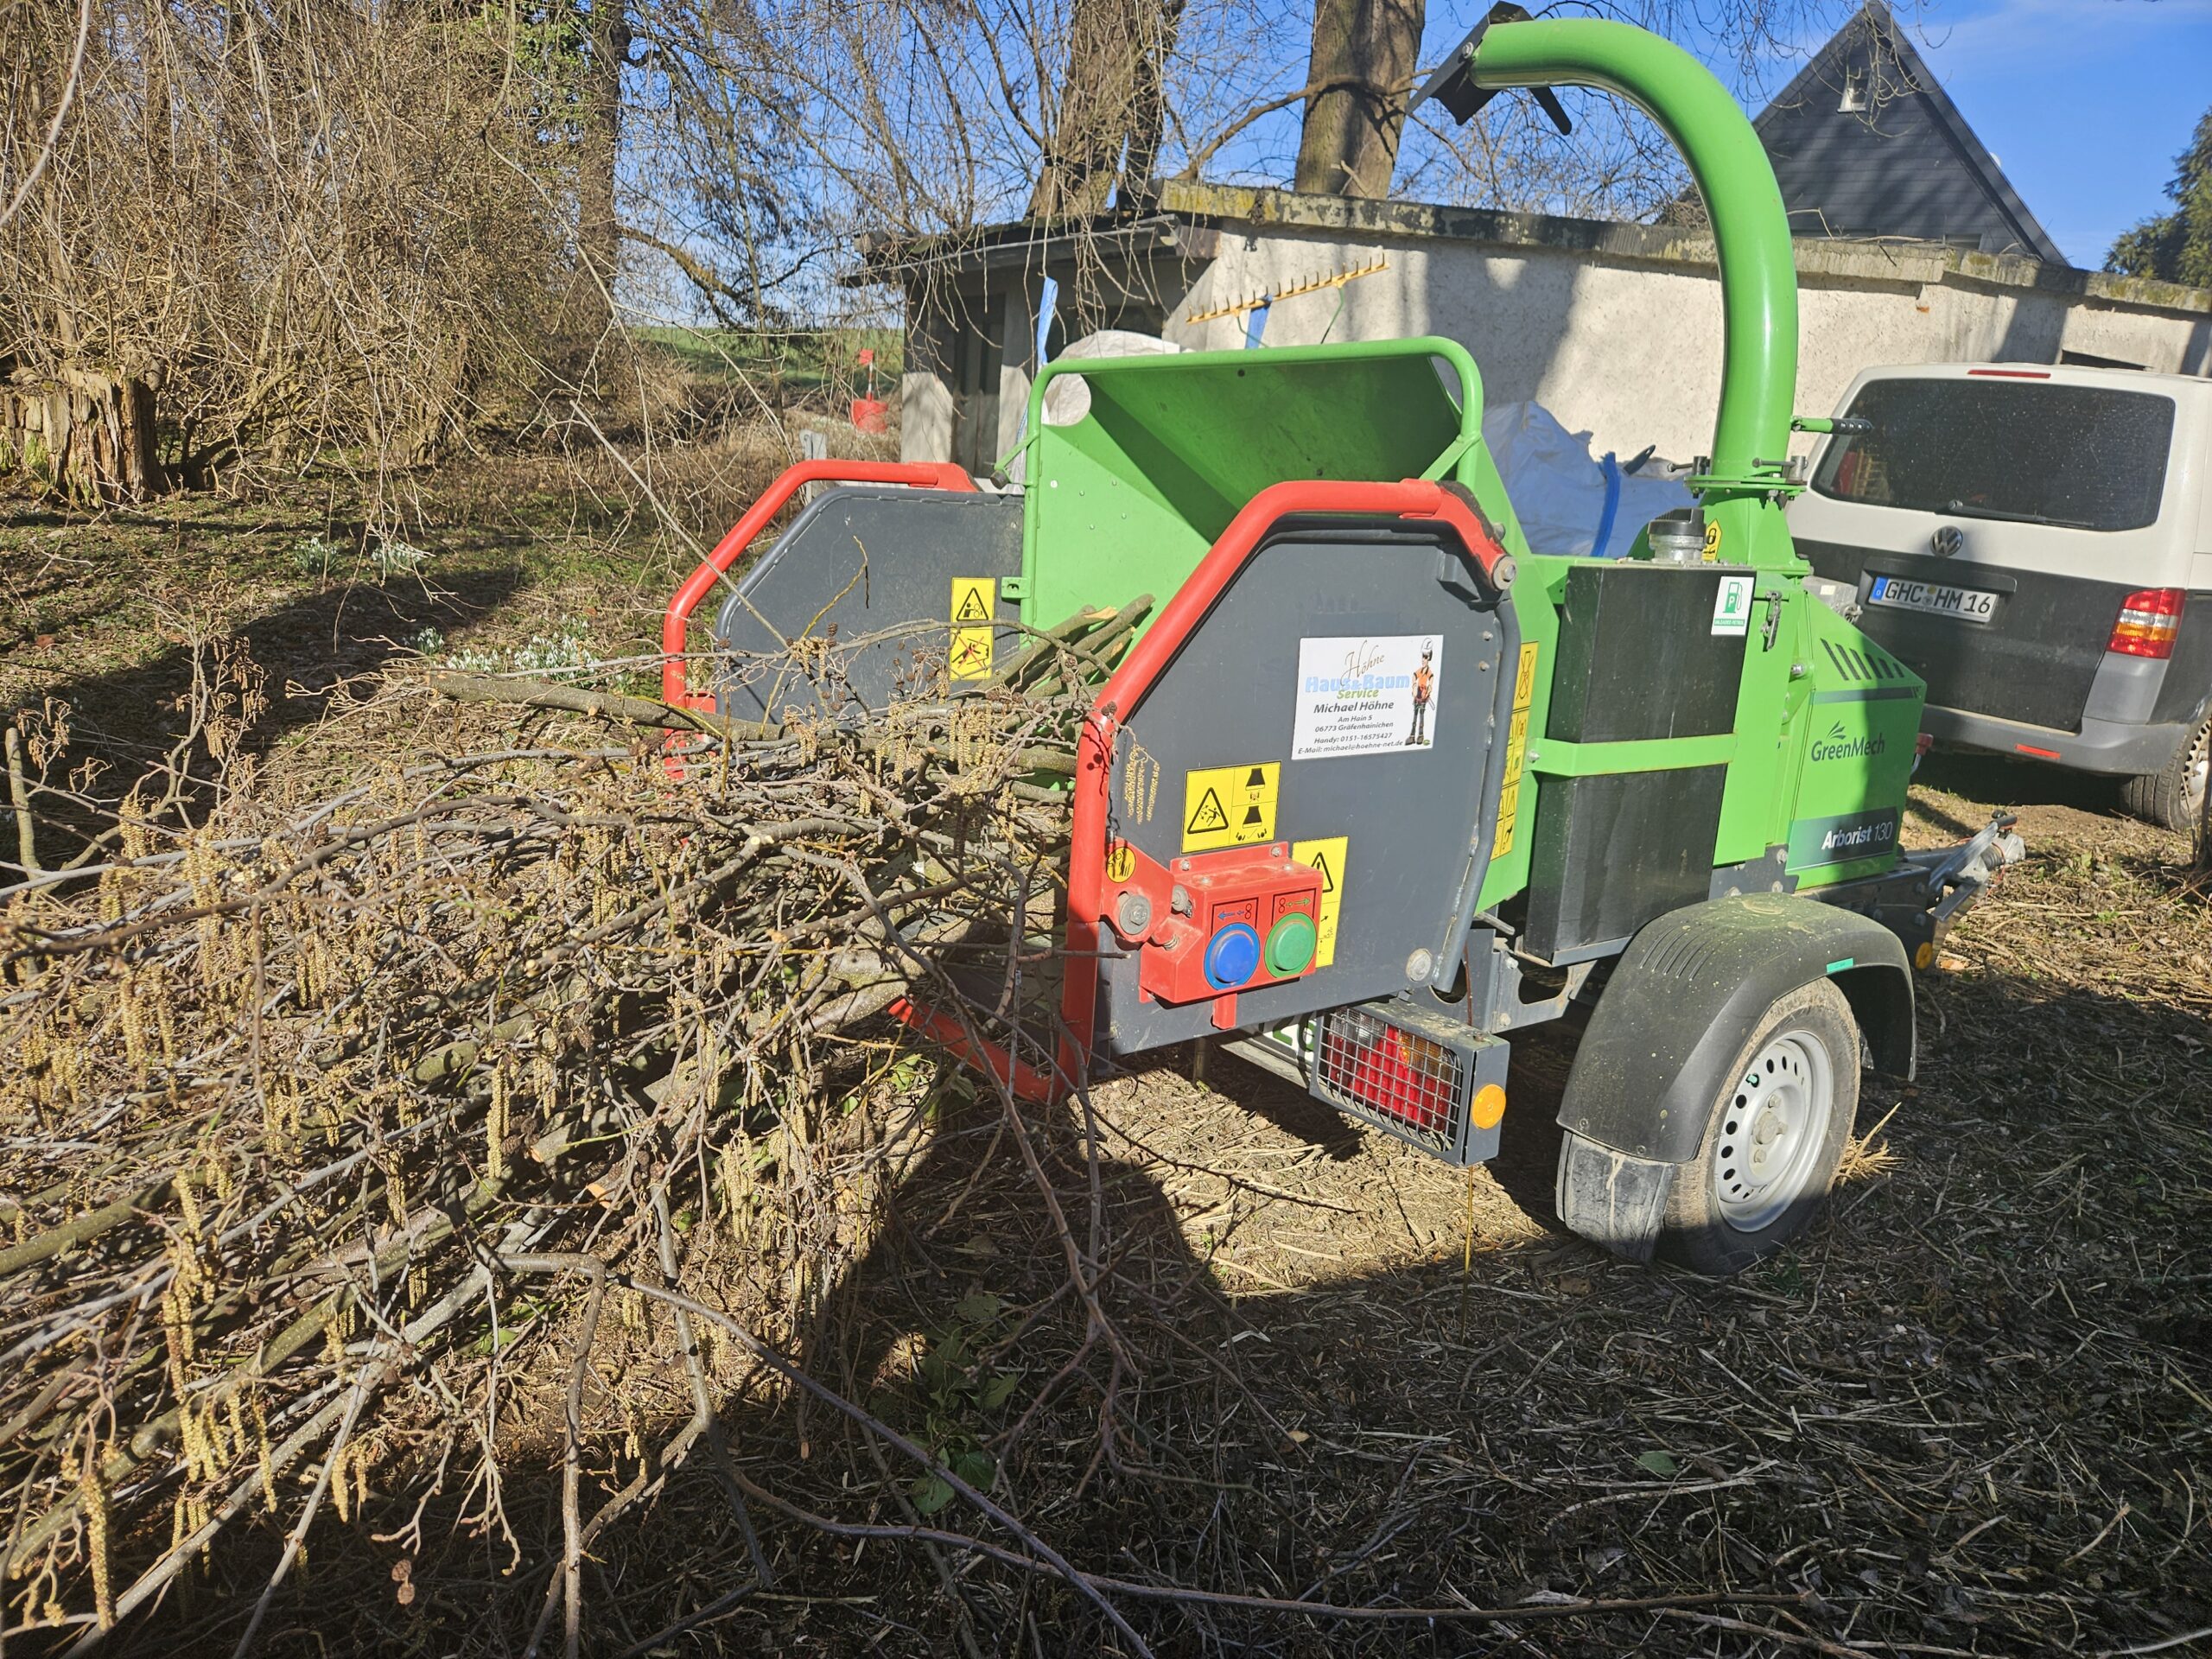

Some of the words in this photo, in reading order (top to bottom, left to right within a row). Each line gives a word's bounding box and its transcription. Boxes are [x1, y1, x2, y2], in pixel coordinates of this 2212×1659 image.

[1885, 582, 1924, 603] GHC
[1934, 588, 1963, 609] HM
[1963, 594, 1991, 613] 16
[1340, 639, 1384, 686] Höhne
[1306, 674, 1409, 692] Haus&Baum
[1337, 689, 1379, 699] Service
[1313, 702, 1357, 713] Michael
[1359, 701, 1394, 711] Höhne
[1338, 721, 1394, 731] Gräfenhainichen
[1340, 732, 1393, 742] 0151-16575427
[1323, 740, 1403, 752] michael@hoehne-net.de
[1811, 732, 1885, 761] GreenMech
[1821, 825, 1872, 850] Arborist
[1874, 821, 1893, 842] 130
